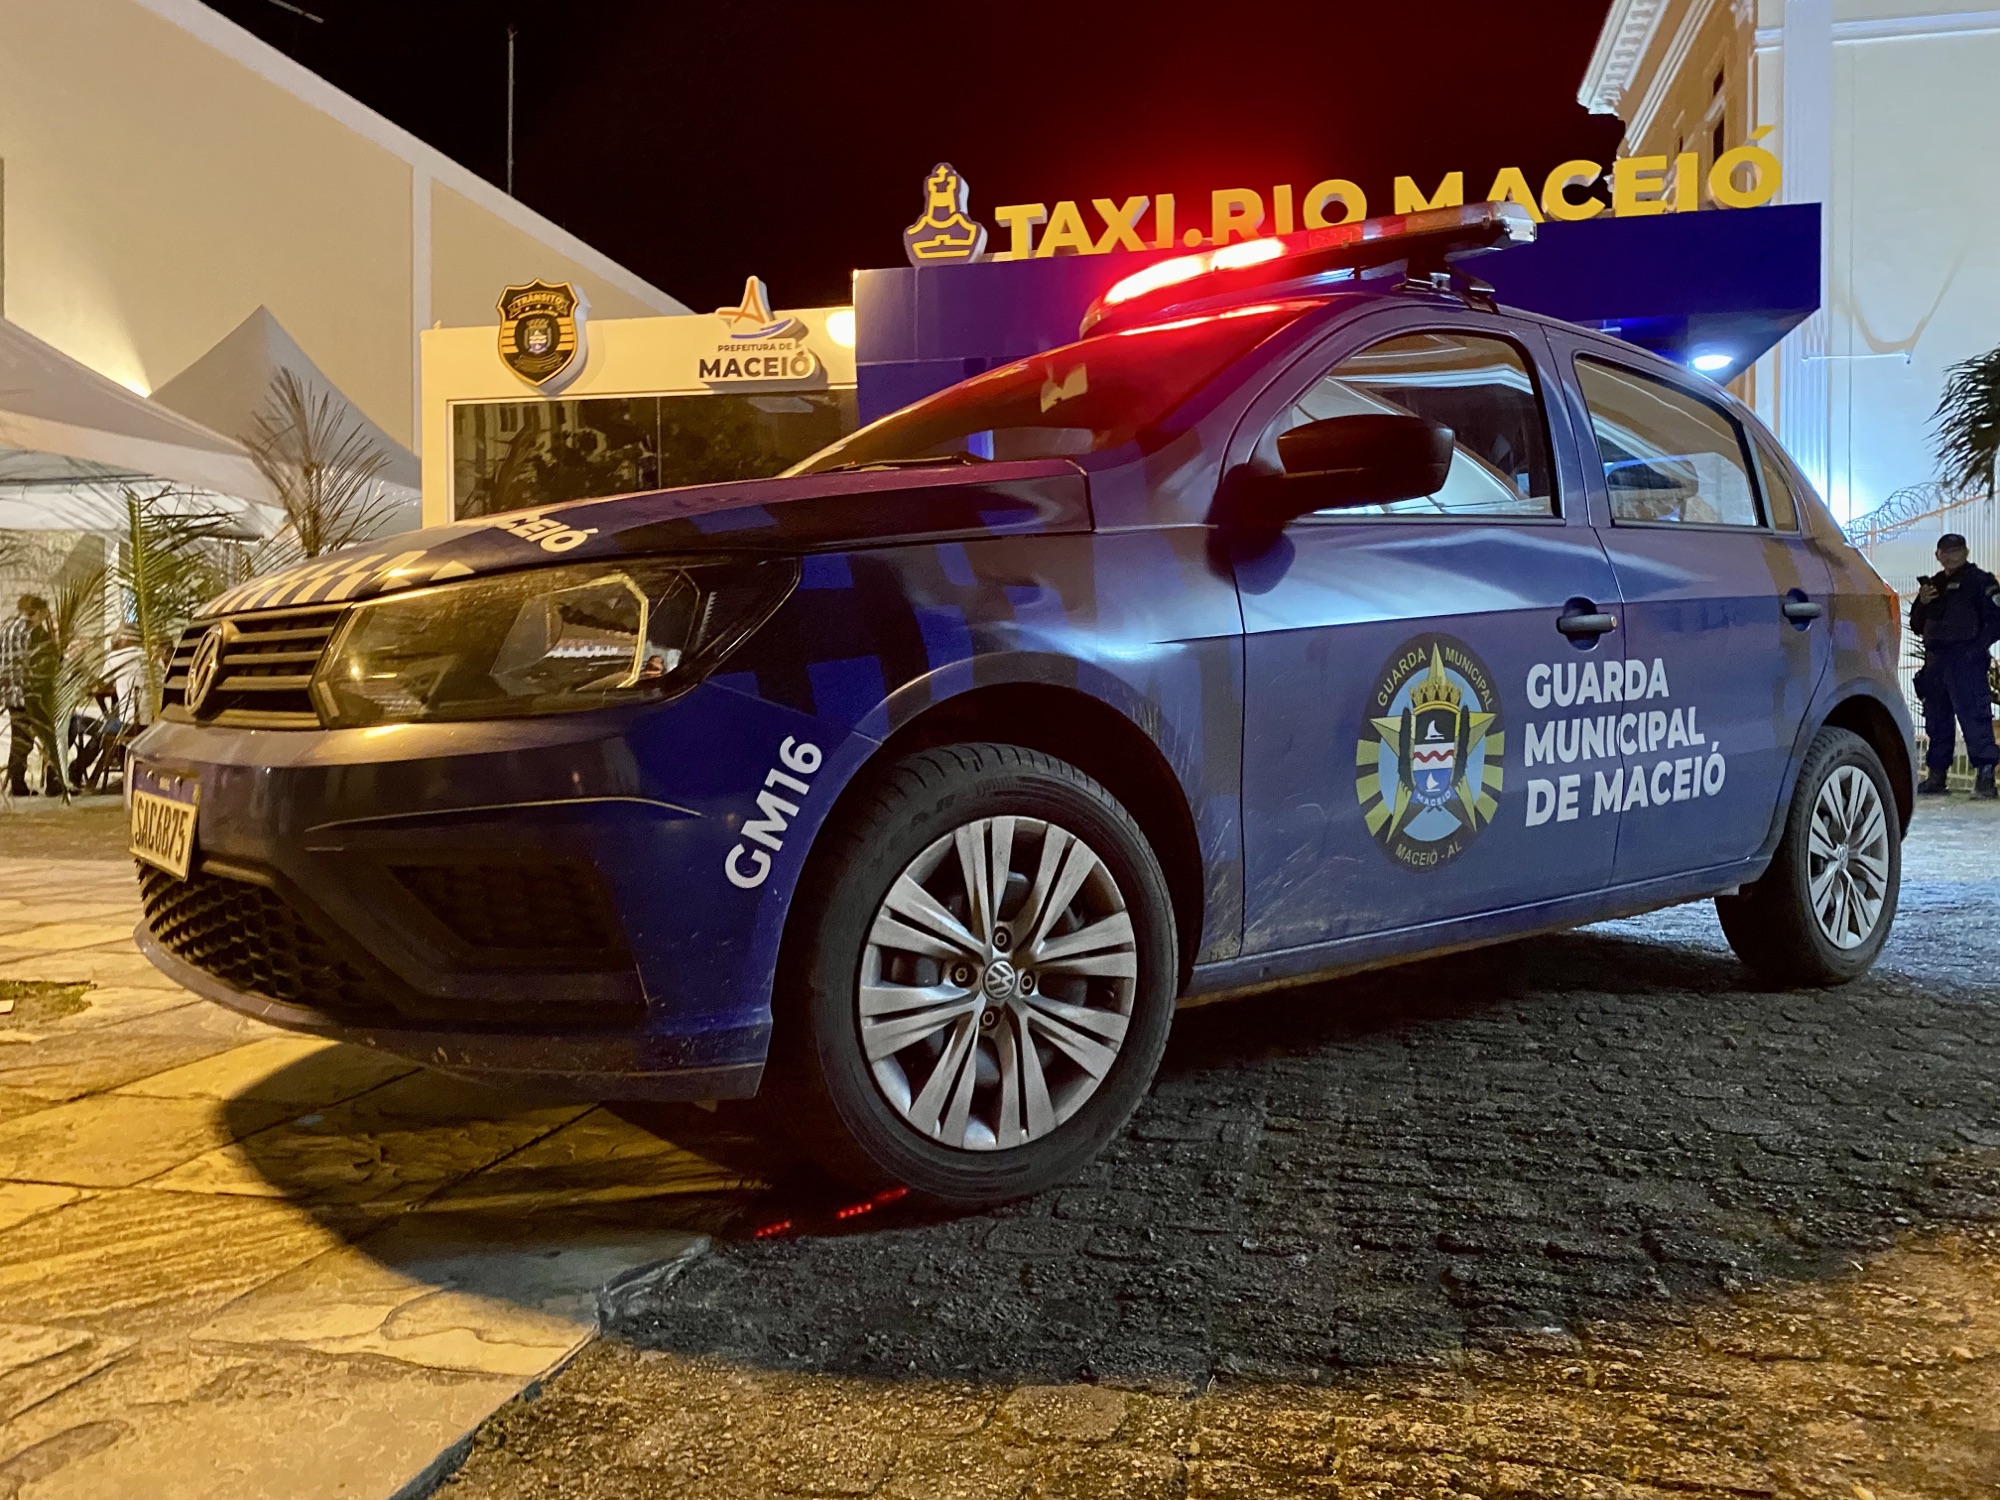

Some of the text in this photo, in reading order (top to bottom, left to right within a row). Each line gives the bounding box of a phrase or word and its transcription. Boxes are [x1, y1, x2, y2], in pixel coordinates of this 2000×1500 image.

[1394, 125, 1782, 223] MACEIÓ
[699, 351, 811, 378] MACEIÓ
[718, 343, 776, 352] PREFEITURA
[1377, 647, 1493, 711] GUARDA MUNICIPAL
[1526, 658, 1670, 709] GUARDA
[1524, 706, 1706, 767] MUNICIPAL
[725, 735, 823, 889] GM16
[1525, 741, 1726, 827] DE MACEIÓ
[1395, 843, 1438, 866] MACEIÓ
[1447, 841, 1463, 858] AL
